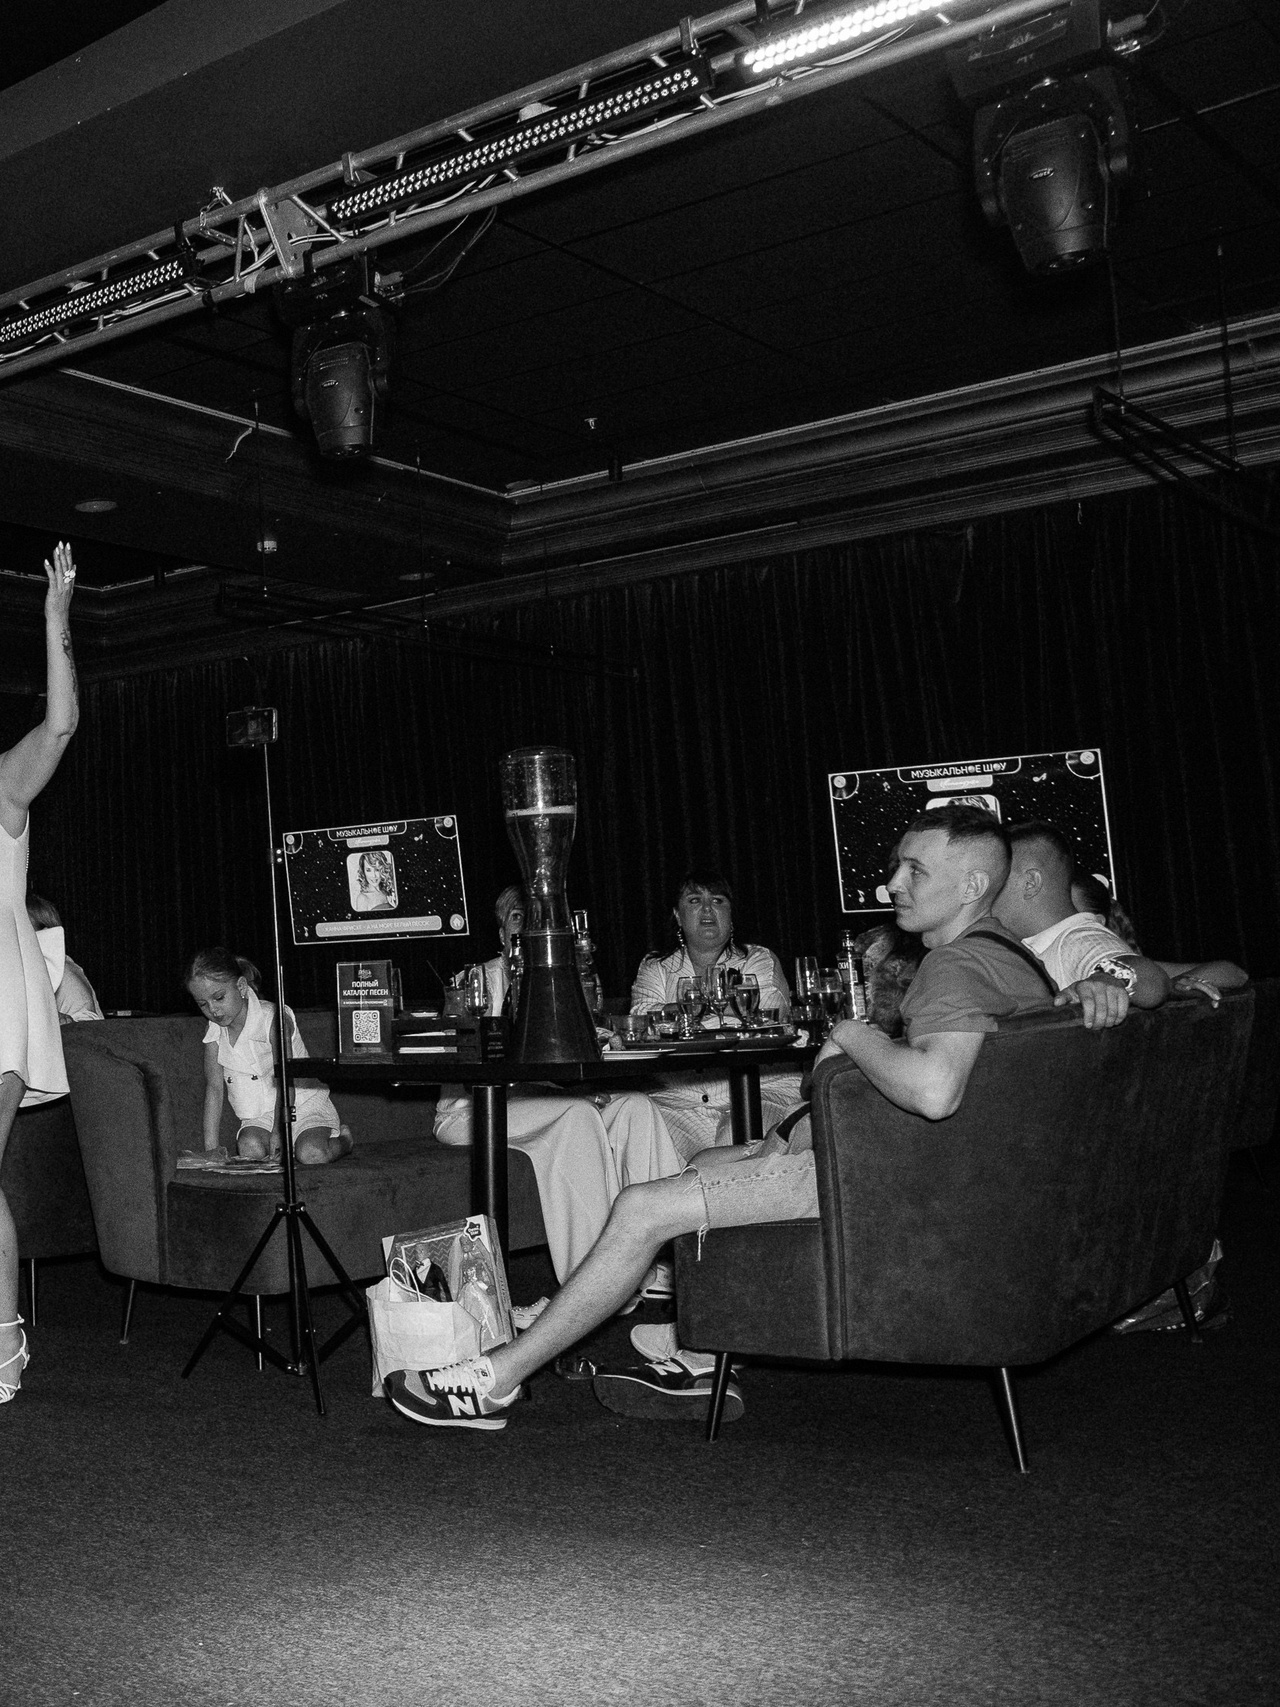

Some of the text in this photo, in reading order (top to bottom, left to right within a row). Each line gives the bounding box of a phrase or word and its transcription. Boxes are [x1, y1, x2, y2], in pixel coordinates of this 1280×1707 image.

[351, 979, 379, 988] ПОЛНЫЙ
[369, 988, 389, 996] ПЕСЕН
[447, 1394, 477, 1416] N
